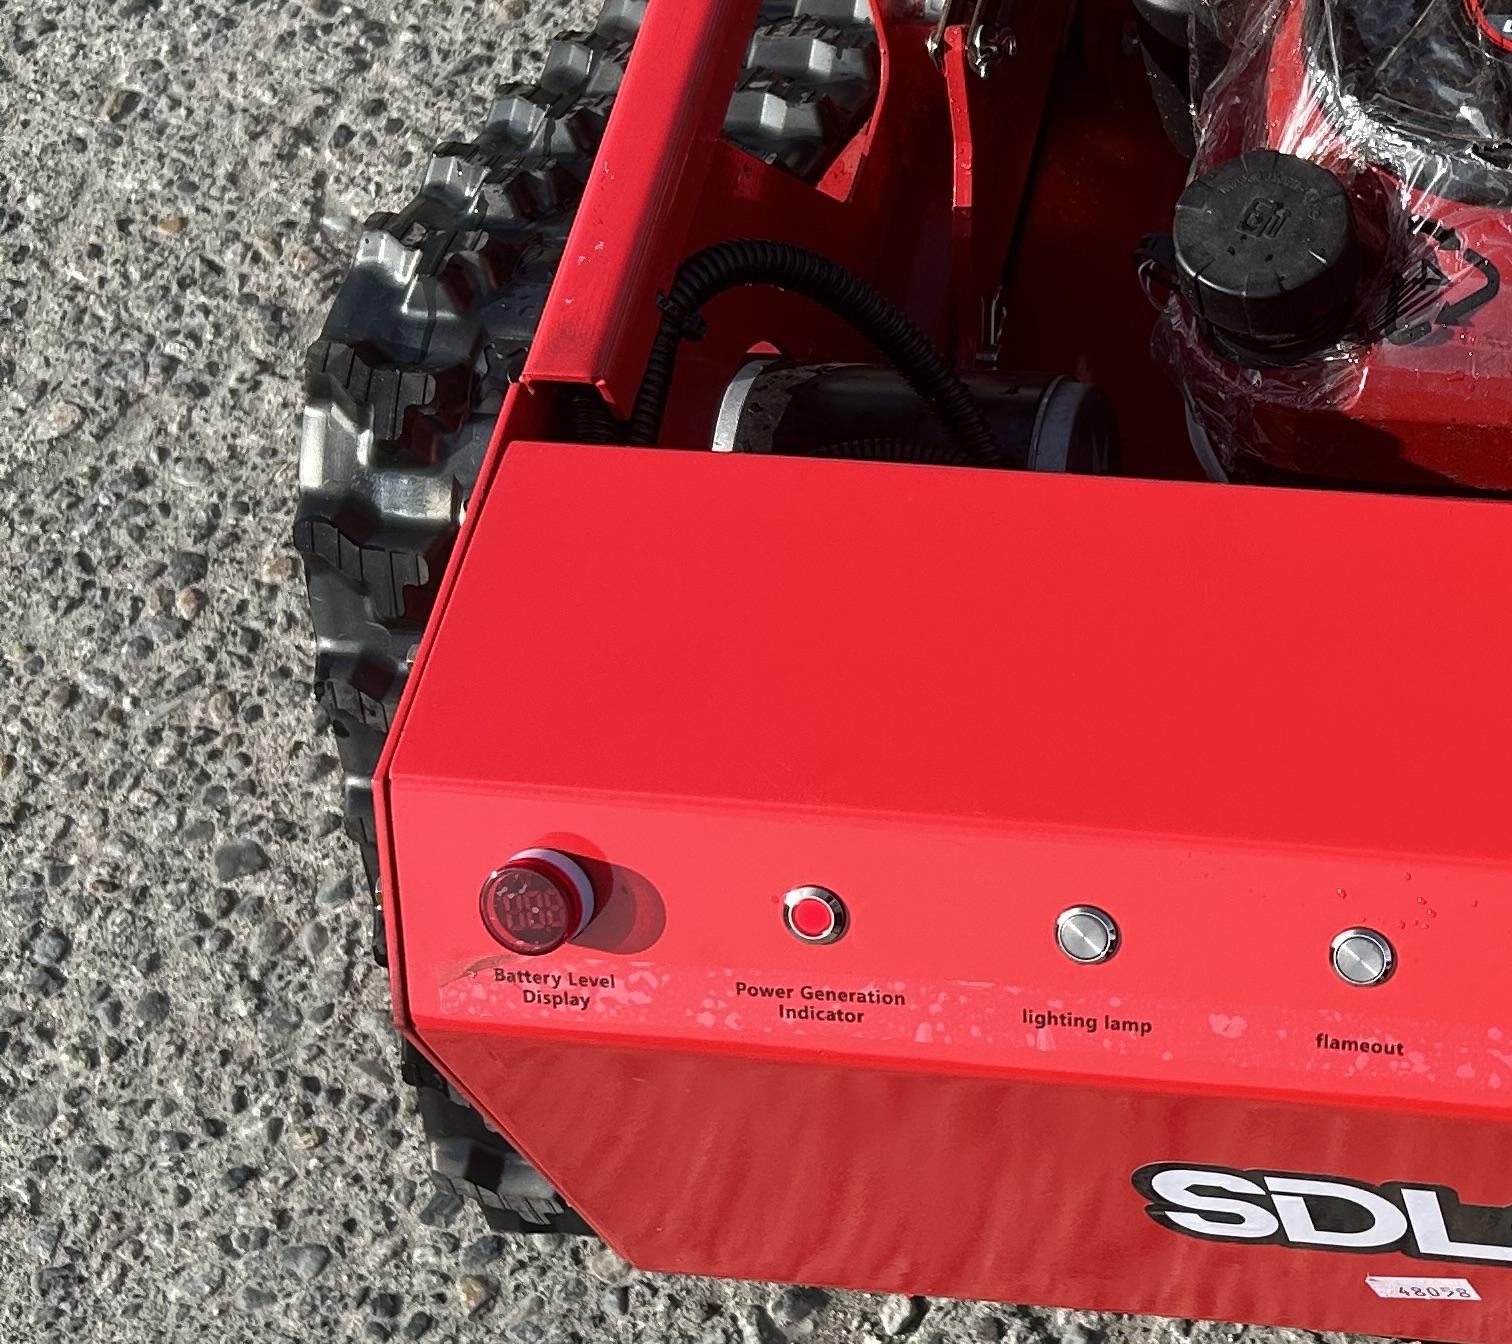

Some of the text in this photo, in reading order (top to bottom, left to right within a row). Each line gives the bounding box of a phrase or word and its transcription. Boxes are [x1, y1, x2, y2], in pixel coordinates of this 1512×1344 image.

[493, 967, 616, 989] Battery Level
[522, 989, 591, 1010] Display
[735, 981, 907, 1007] Power Generation
[778, 1004, 865, 1024] Indicator
[1021, 1008, 1153, 1036] lighting lamp
[1314, 1032, 1405, 1057] flameout
